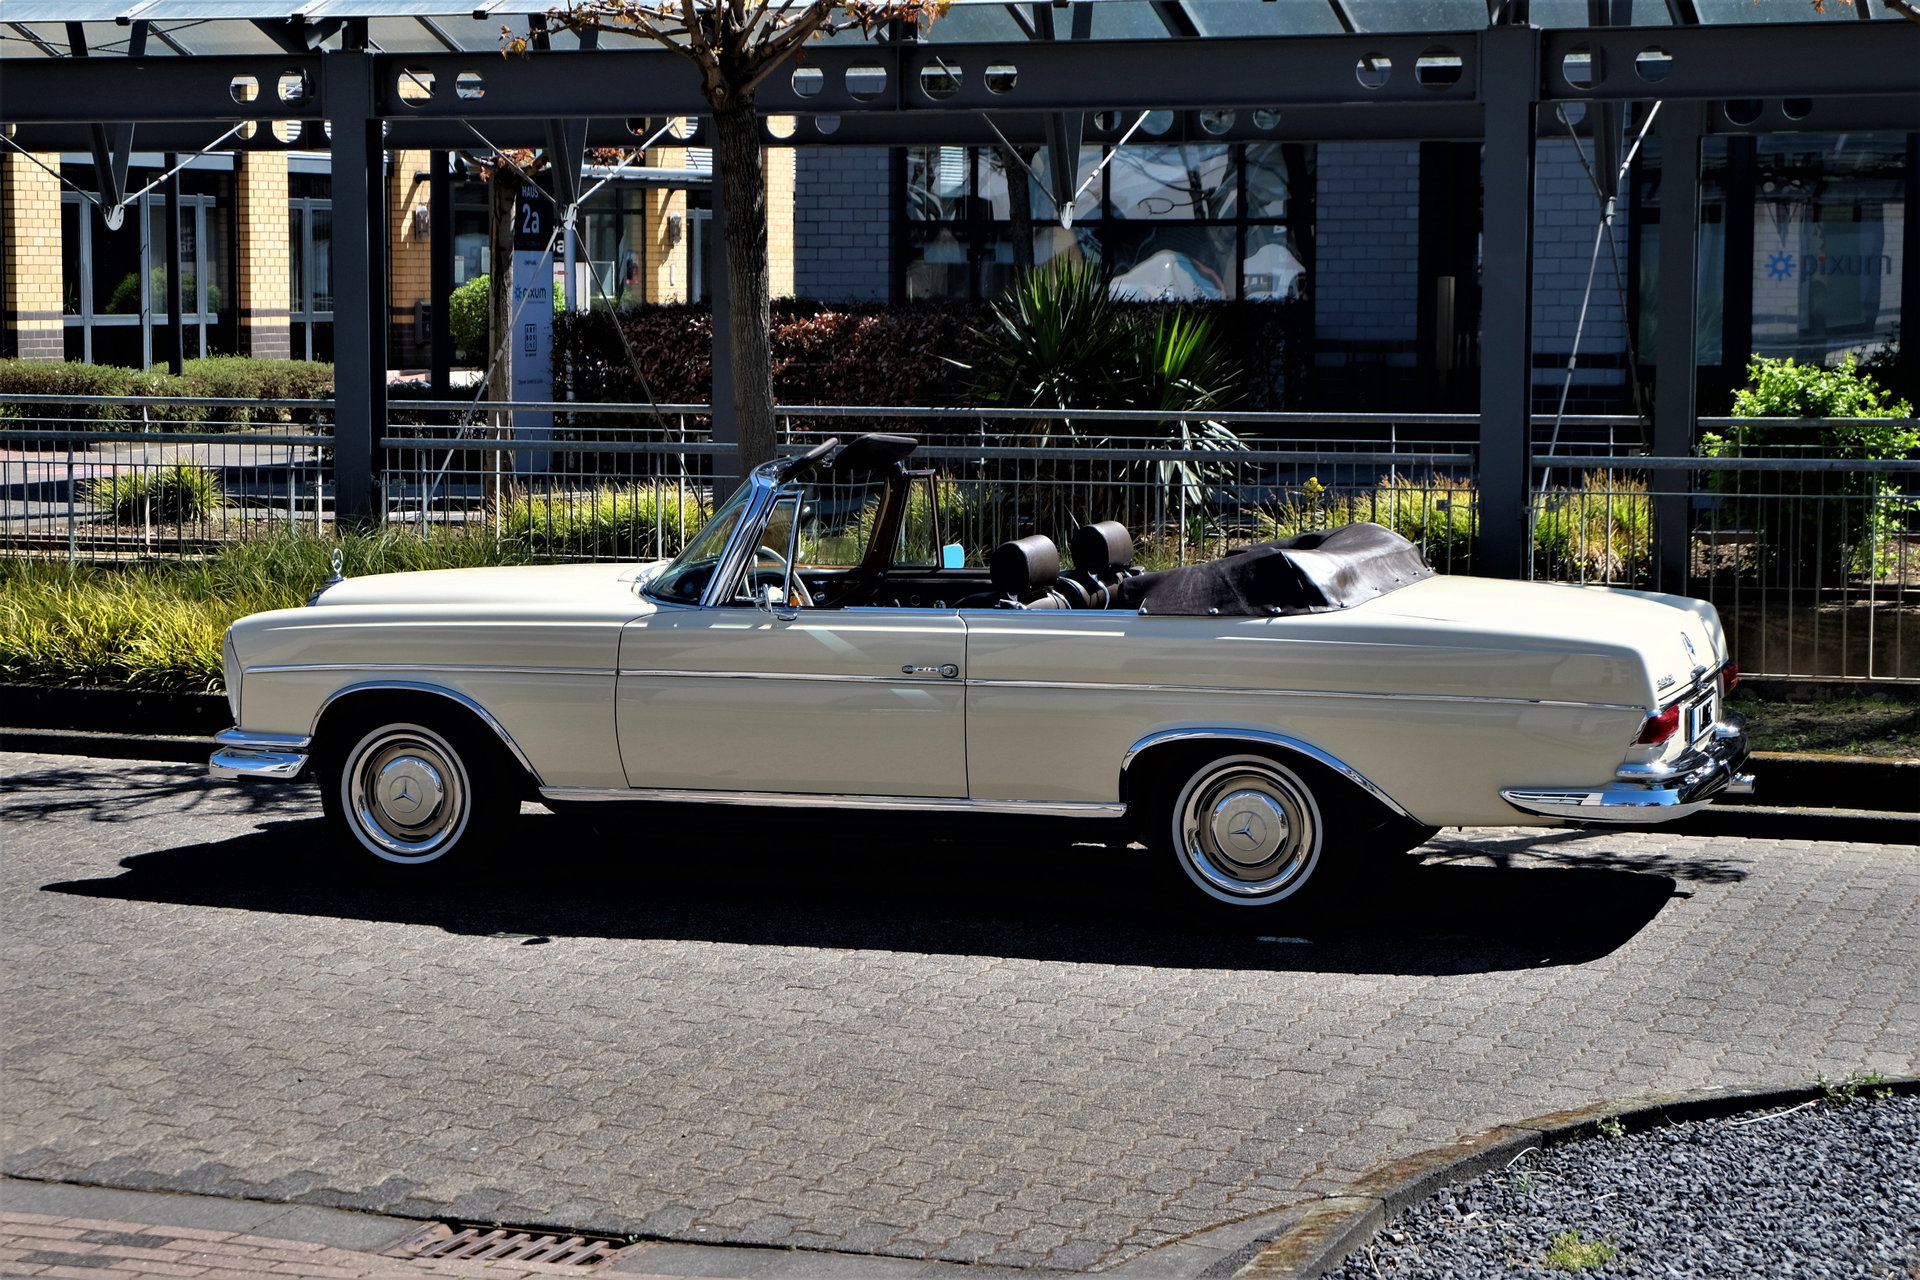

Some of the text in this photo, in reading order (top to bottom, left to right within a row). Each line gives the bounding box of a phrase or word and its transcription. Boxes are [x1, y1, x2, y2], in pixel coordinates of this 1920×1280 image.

[522, 185, 539, 198] HAUS
[522, 203, 540, 234] 2a
[1801, 253, 1892, 283] pixum
